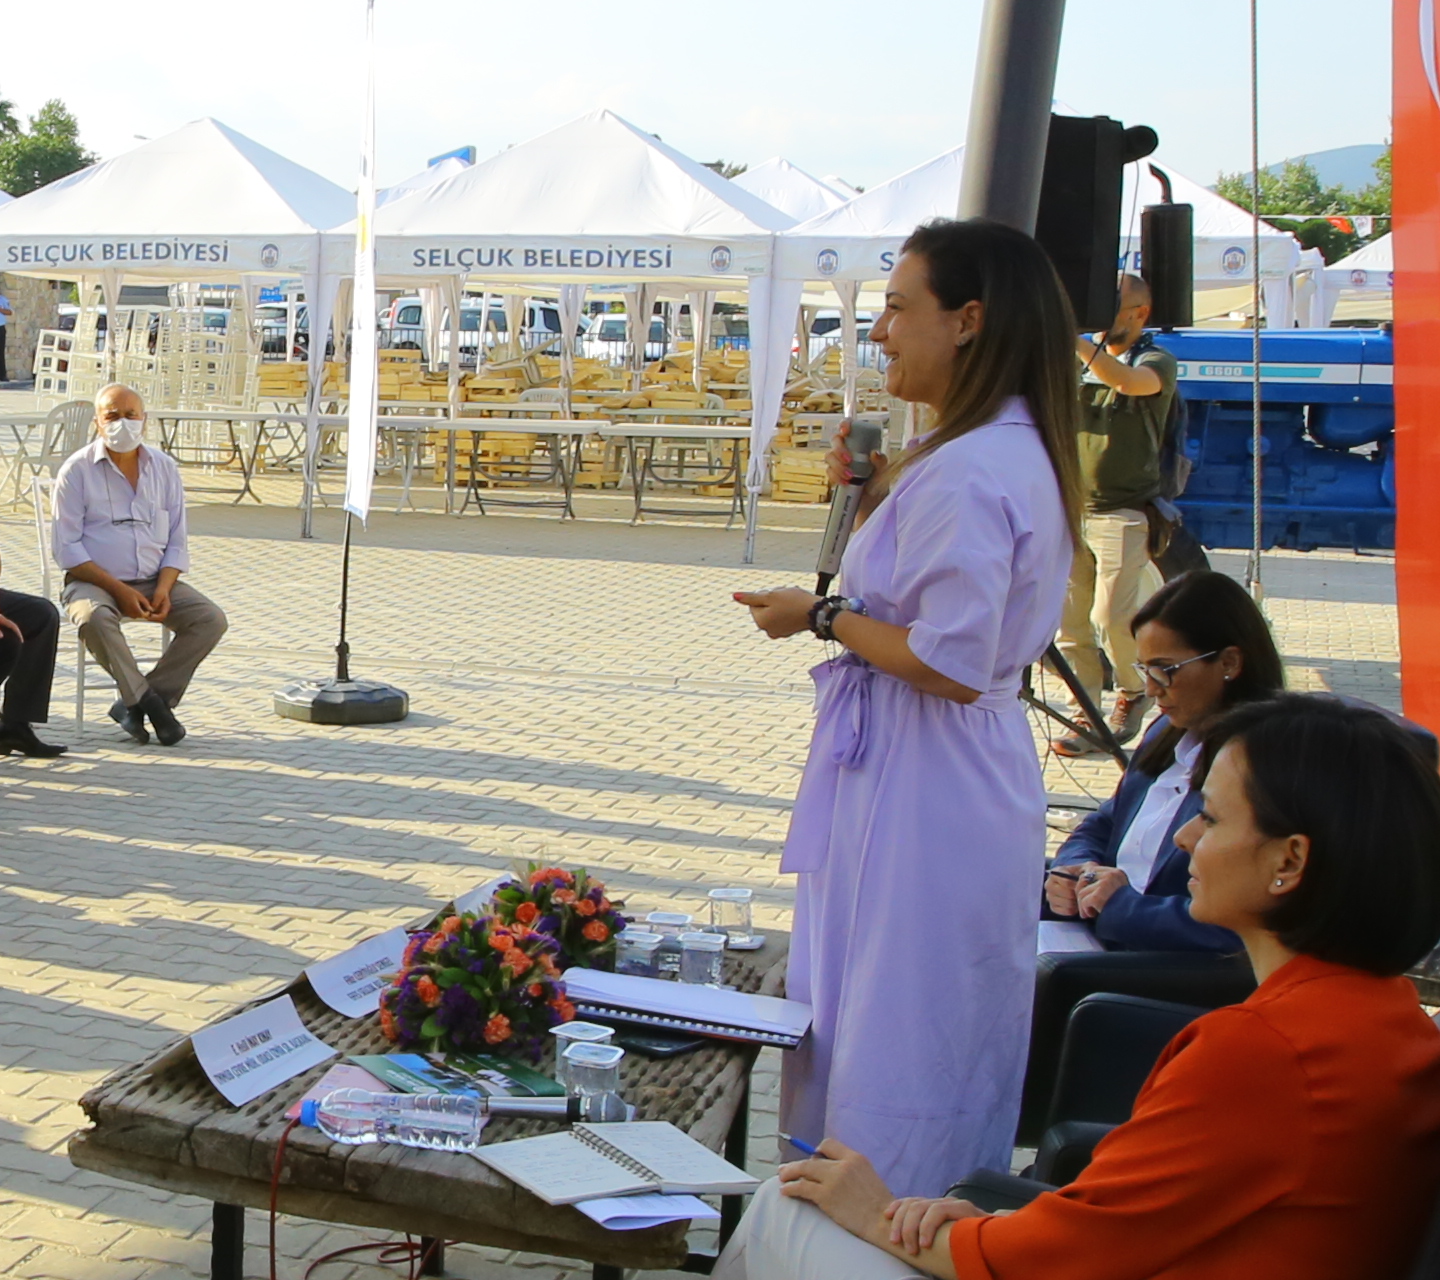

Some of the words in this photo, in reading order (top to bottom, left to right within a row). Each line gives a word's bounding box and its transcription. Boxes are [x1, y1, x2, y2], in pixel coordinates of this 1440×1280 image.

[7, 243, 95, 268] SELÇUK
[102, 237, 229, 263] BELEDİYESİ
[412, 247, 515, 272] SELÇUK
[522, 244, 673, 269] BELEDİYESİ
